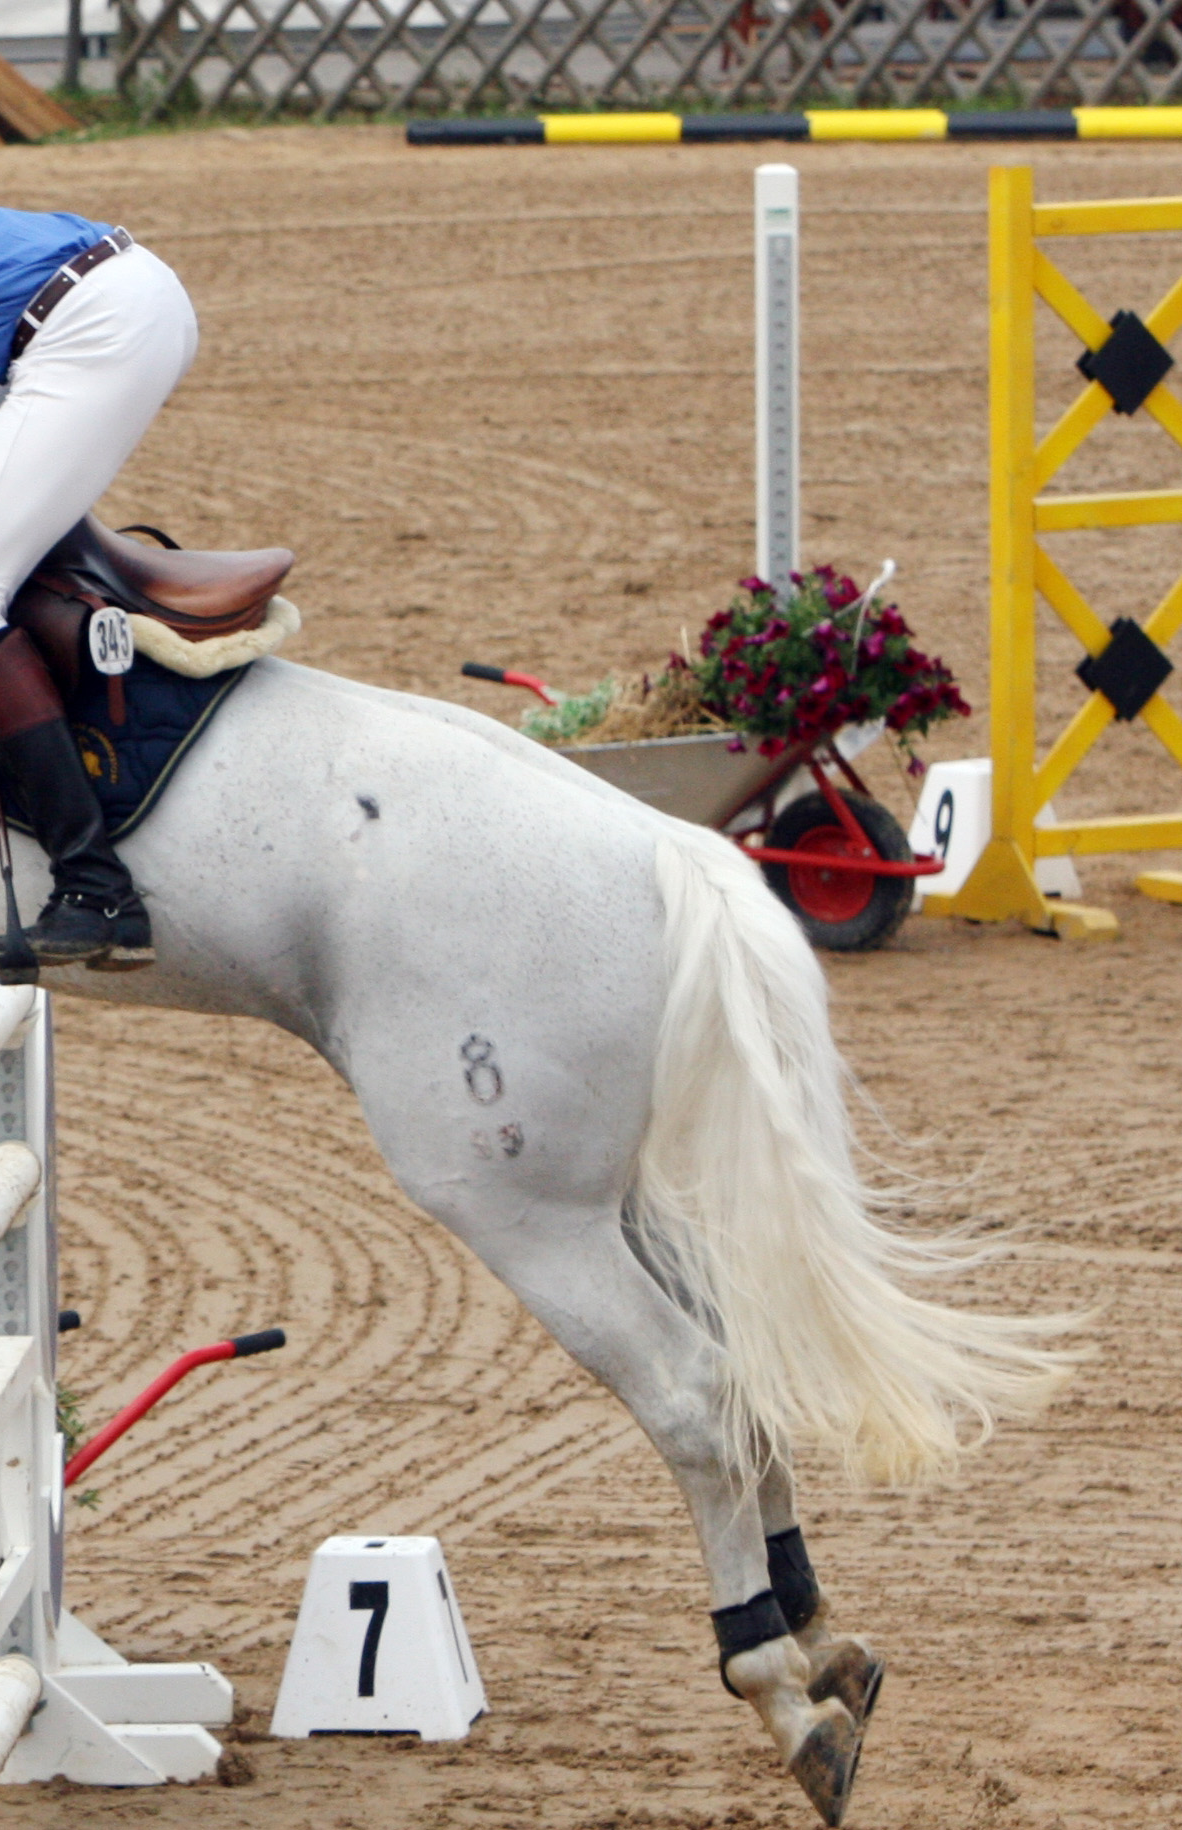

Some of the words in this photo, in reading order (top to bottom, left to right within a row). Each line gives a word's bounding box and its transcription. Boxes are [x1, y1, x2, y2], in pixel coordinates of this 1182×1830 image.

[97, 617, 129, 662] 345
[931, 789, 953, 859] 9
[349, 1581, 388, 1697] 7
